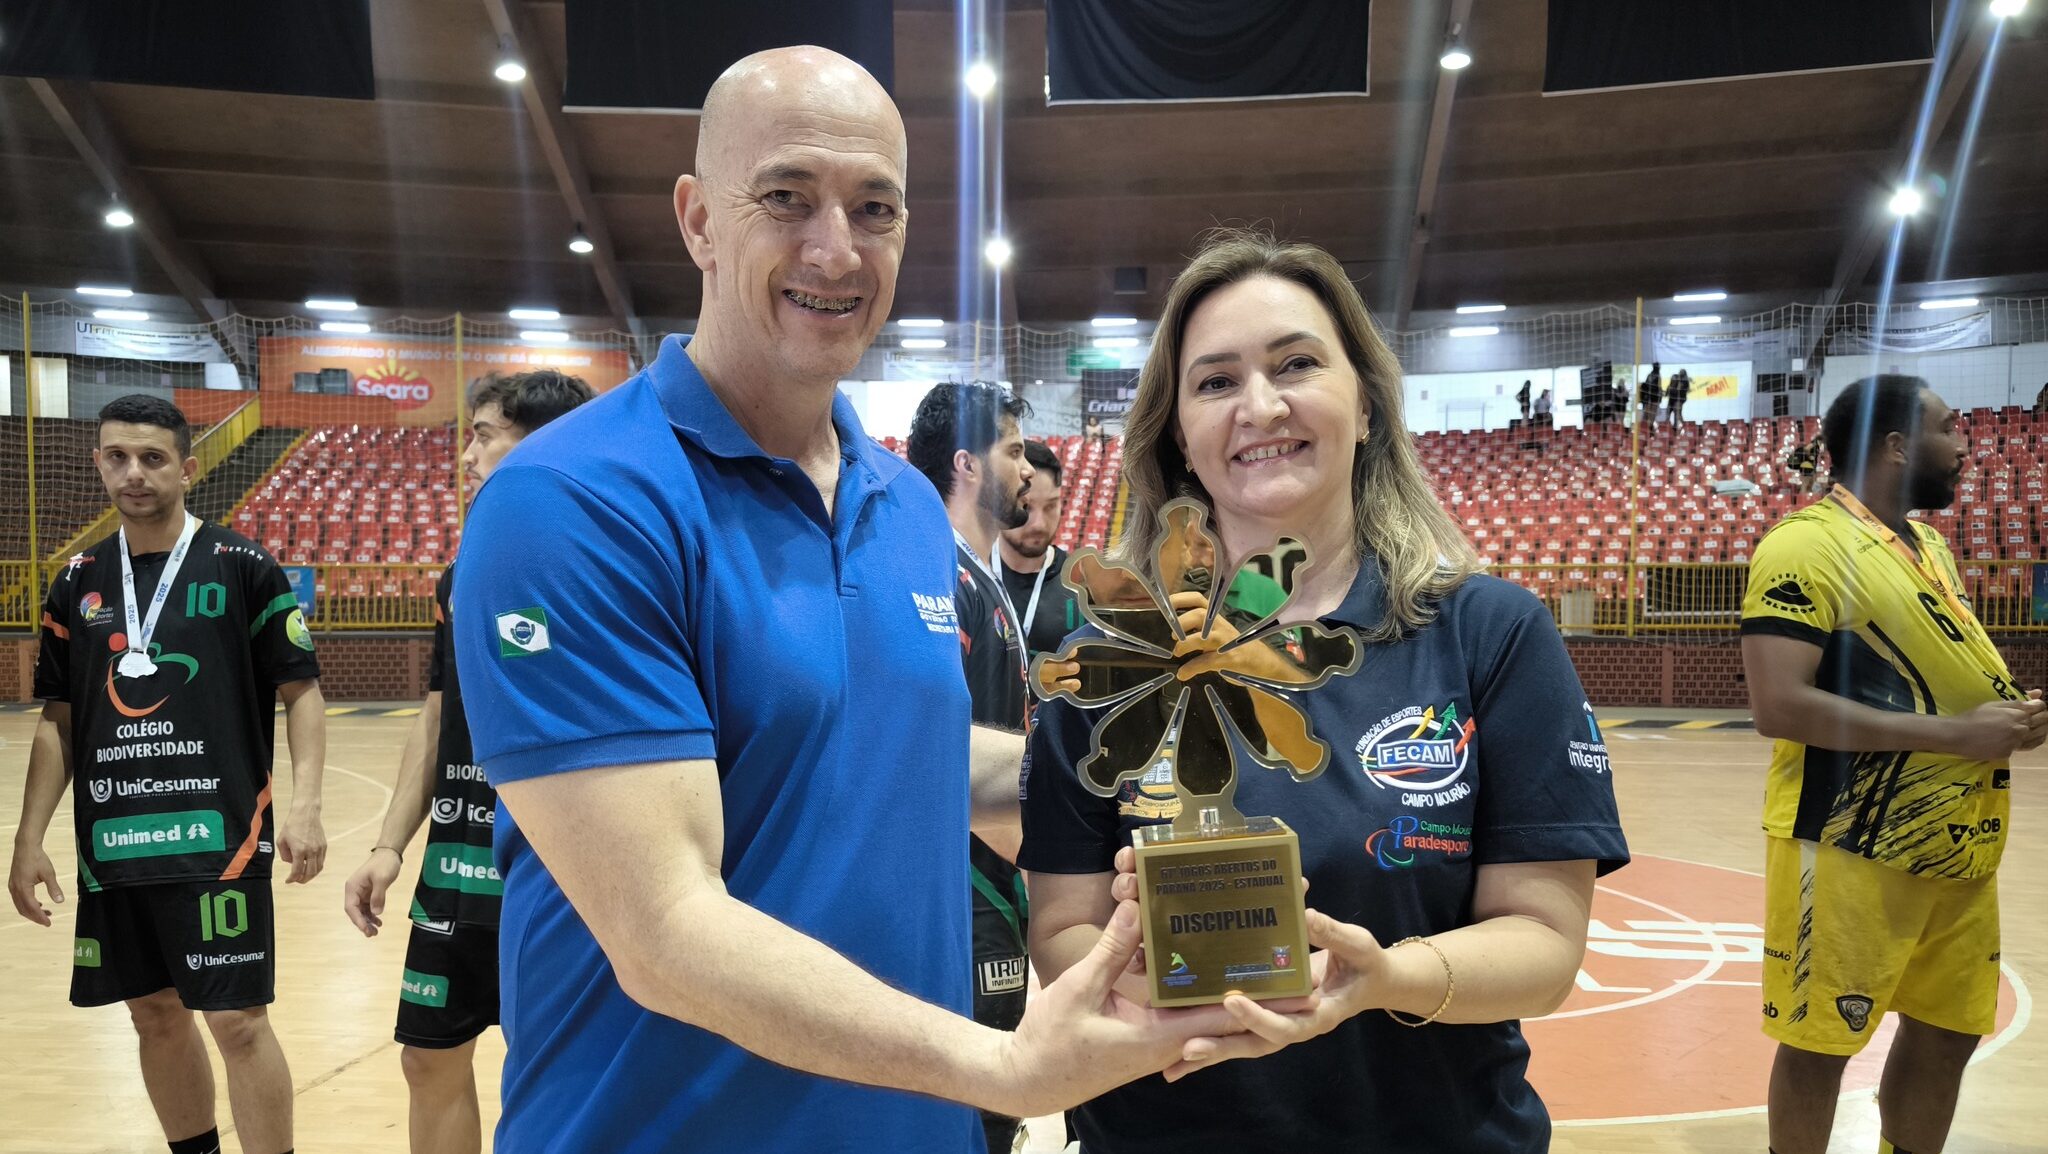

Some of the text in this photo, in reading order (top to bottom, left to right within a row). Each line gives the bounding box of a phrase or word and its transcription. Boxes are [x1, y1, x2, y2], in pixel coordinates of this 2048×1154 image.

[356, 379, 430, 400] Seara
[155, 582, 169, 603] 2025
[185, 581, 227, 618] 10
[127, 603, 137, 625] 2025
[1761, 596, 1817, 614] TELECOM
[116, 719, 174, 739] COLÉGIO
[1355, 705, 1422, 753] FUNDAÇÃO DE ESPORTES
[96, 741, 204, 763] BIODIVERSIDADE
[1382, 745, 1451, 763] FECAM
[116, 778, 220, 796] UniCesumar
[1401, 781, 1472, 808] CAMPO MOURÃO
[103, 825, 181, 847] Unimed
[1420, 821, 1451, 835] Campo
[1214, 860, 1256, 876] ABERTOS
[1258, 859, 1277, 871] DO
[1200, 880, 1225, 892] 2025
[1235, 874, 1285, 890] ESTADUAL
[200, 889, 248, 942] 10
[1170, 906, 1278, 935] DISCIPLINA
[204, 951, 265, 967] UniCesumar
